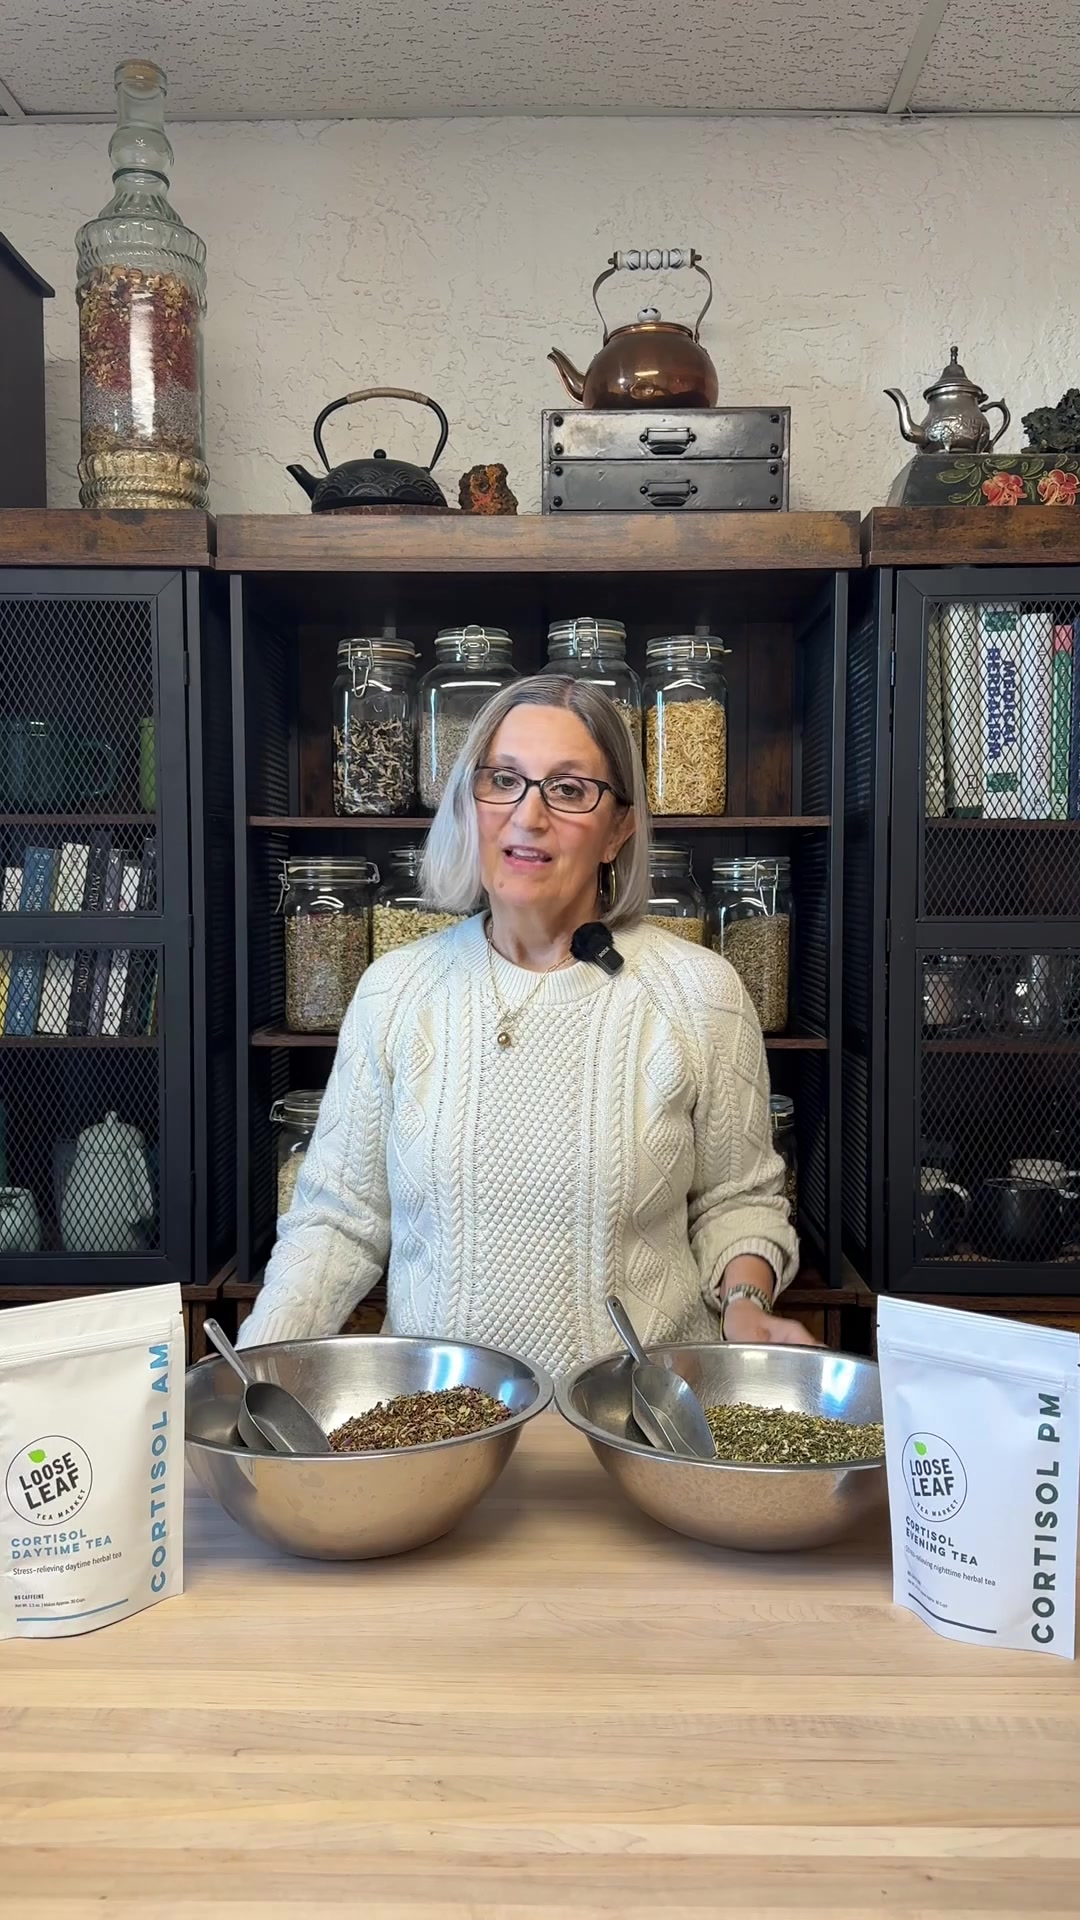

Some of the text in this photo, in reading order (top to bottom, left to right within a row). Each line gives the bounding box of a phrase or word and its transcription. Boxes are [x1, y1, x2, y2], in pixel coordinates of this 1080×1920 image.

[986, 647, 1001, 760] HERBALISM
[1002, 660, 1016, 747] MEDICAL
[19, 1452, 76, 1490] LOOSE
[149, 1343, 170, 1592] CORTISOL AM
[909, 1458, 952, 1476] LOOSE
[25, 1467, 79, 1510] LEAF
[912, 1476, 954, 1496] LEAF
[58, 1489, 85, 1518] MARKET
[916, 1499, 958, 1516] TEA MARKET
[1031, 1392, 1062, 1644] CORTISOL PM
[11, 1528, 87, 1547] CORTISOL
[905, 1515, 954, 1547] CORTISOL
[12, 1535, 112, 1559] DAYTIME TEA
[906, 1527, 978, 1566] EVENING TEA
[13, 1551, 122, 1576] Stress-relieving daytime herbal tea
[933, 1564, 961, 1579] nighttime
[962, 1572, 983, 1584] herbal
[985, 1578, 996, 1586] tea
